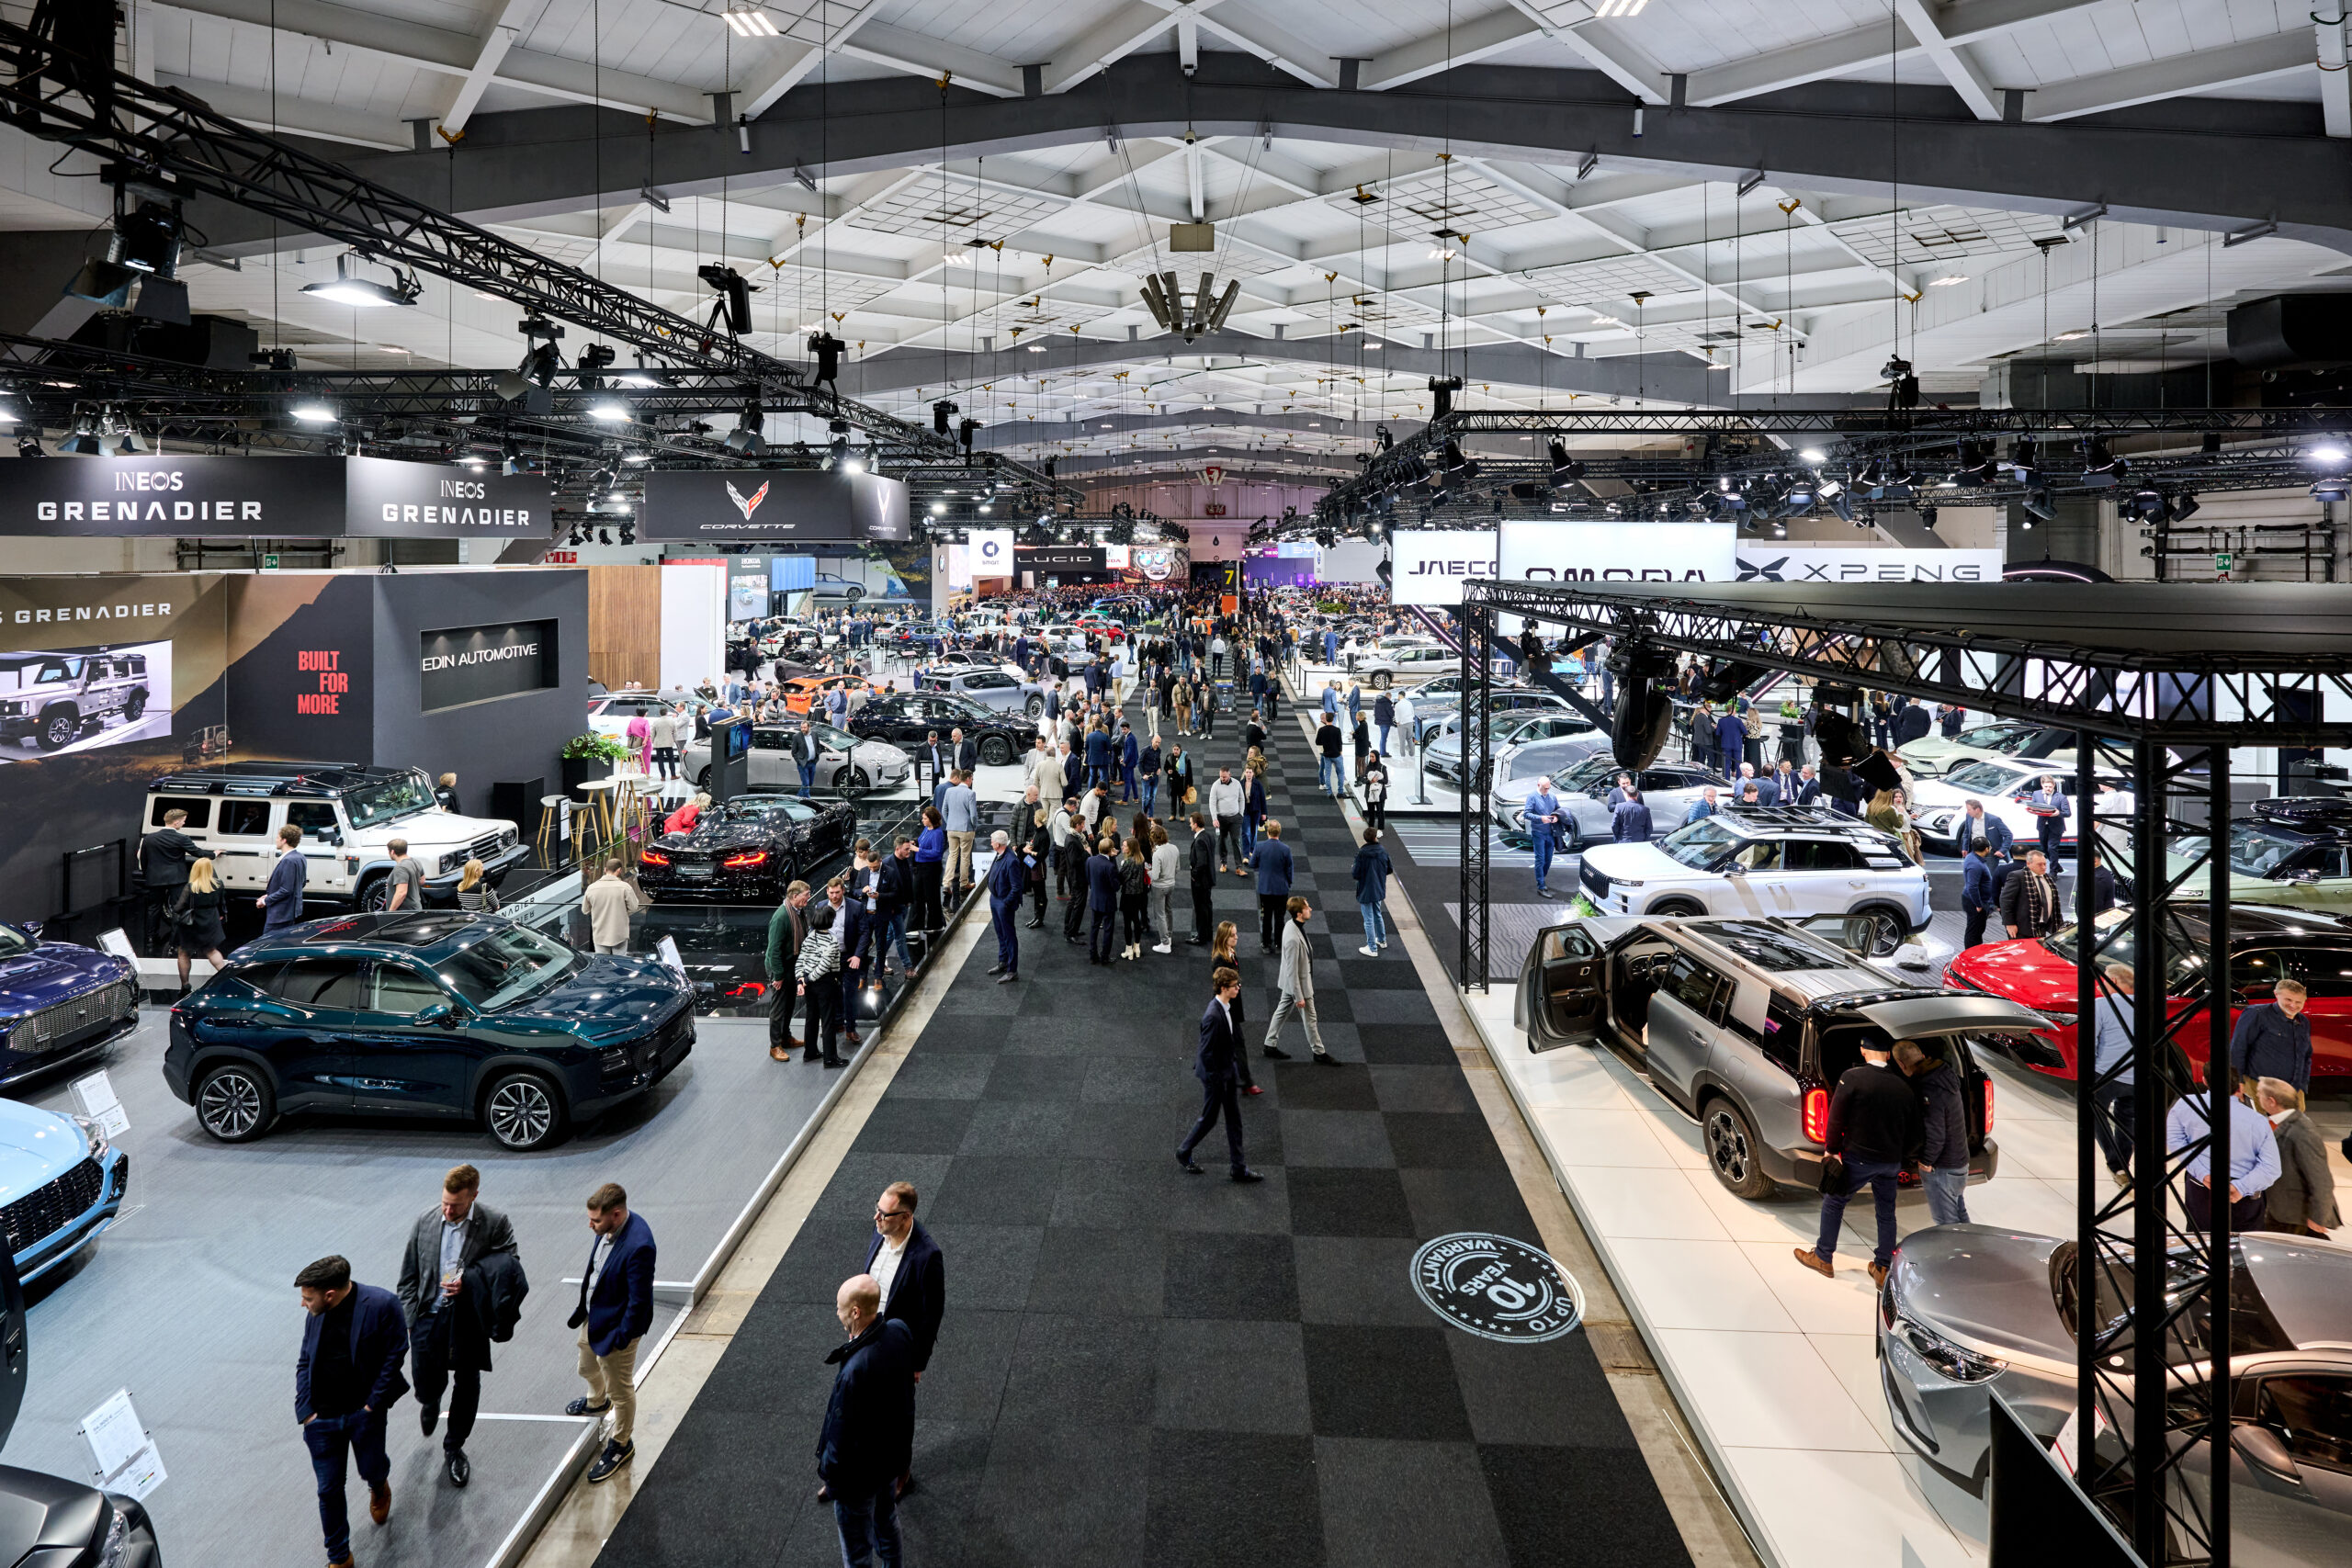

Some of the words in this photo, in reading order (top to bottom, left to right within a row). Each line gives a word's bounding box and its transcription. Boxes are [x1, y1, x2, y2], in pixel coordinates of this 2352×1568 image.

[114, 471, 184, 491] INEOS
[440, 479, 485, 500] INEOS
[38, 501, 262, 521] GRENADIER
[382, 503, 530, 526] GRENADIER
[868, 525, 897, 533] CORVETTE
[1225, 570, 1235, 585] 7
[1804, 563, 1982, 581] XPENG
[15, 603, 171, 624] GRENADIER
[298, 650, 340, 671] BUILT
[422, 654, 455, 671] EDIN
[458, 643, 537, 666] AUTOMOTIVE
[319, 672, 348, 694] FOR
[298, 694, 339, 715] MORE
[497, 897, 536, 918] NADIER
[1422, 1238, 1498, 1291] WARRANTY
[1459, 1259, 1512, 1297] YEARS
[1487, 1276, 1536, 1309] 10
[1554, 1295, 1572, 1315] UP
[1529, 1314, 1560, 1332] TO
